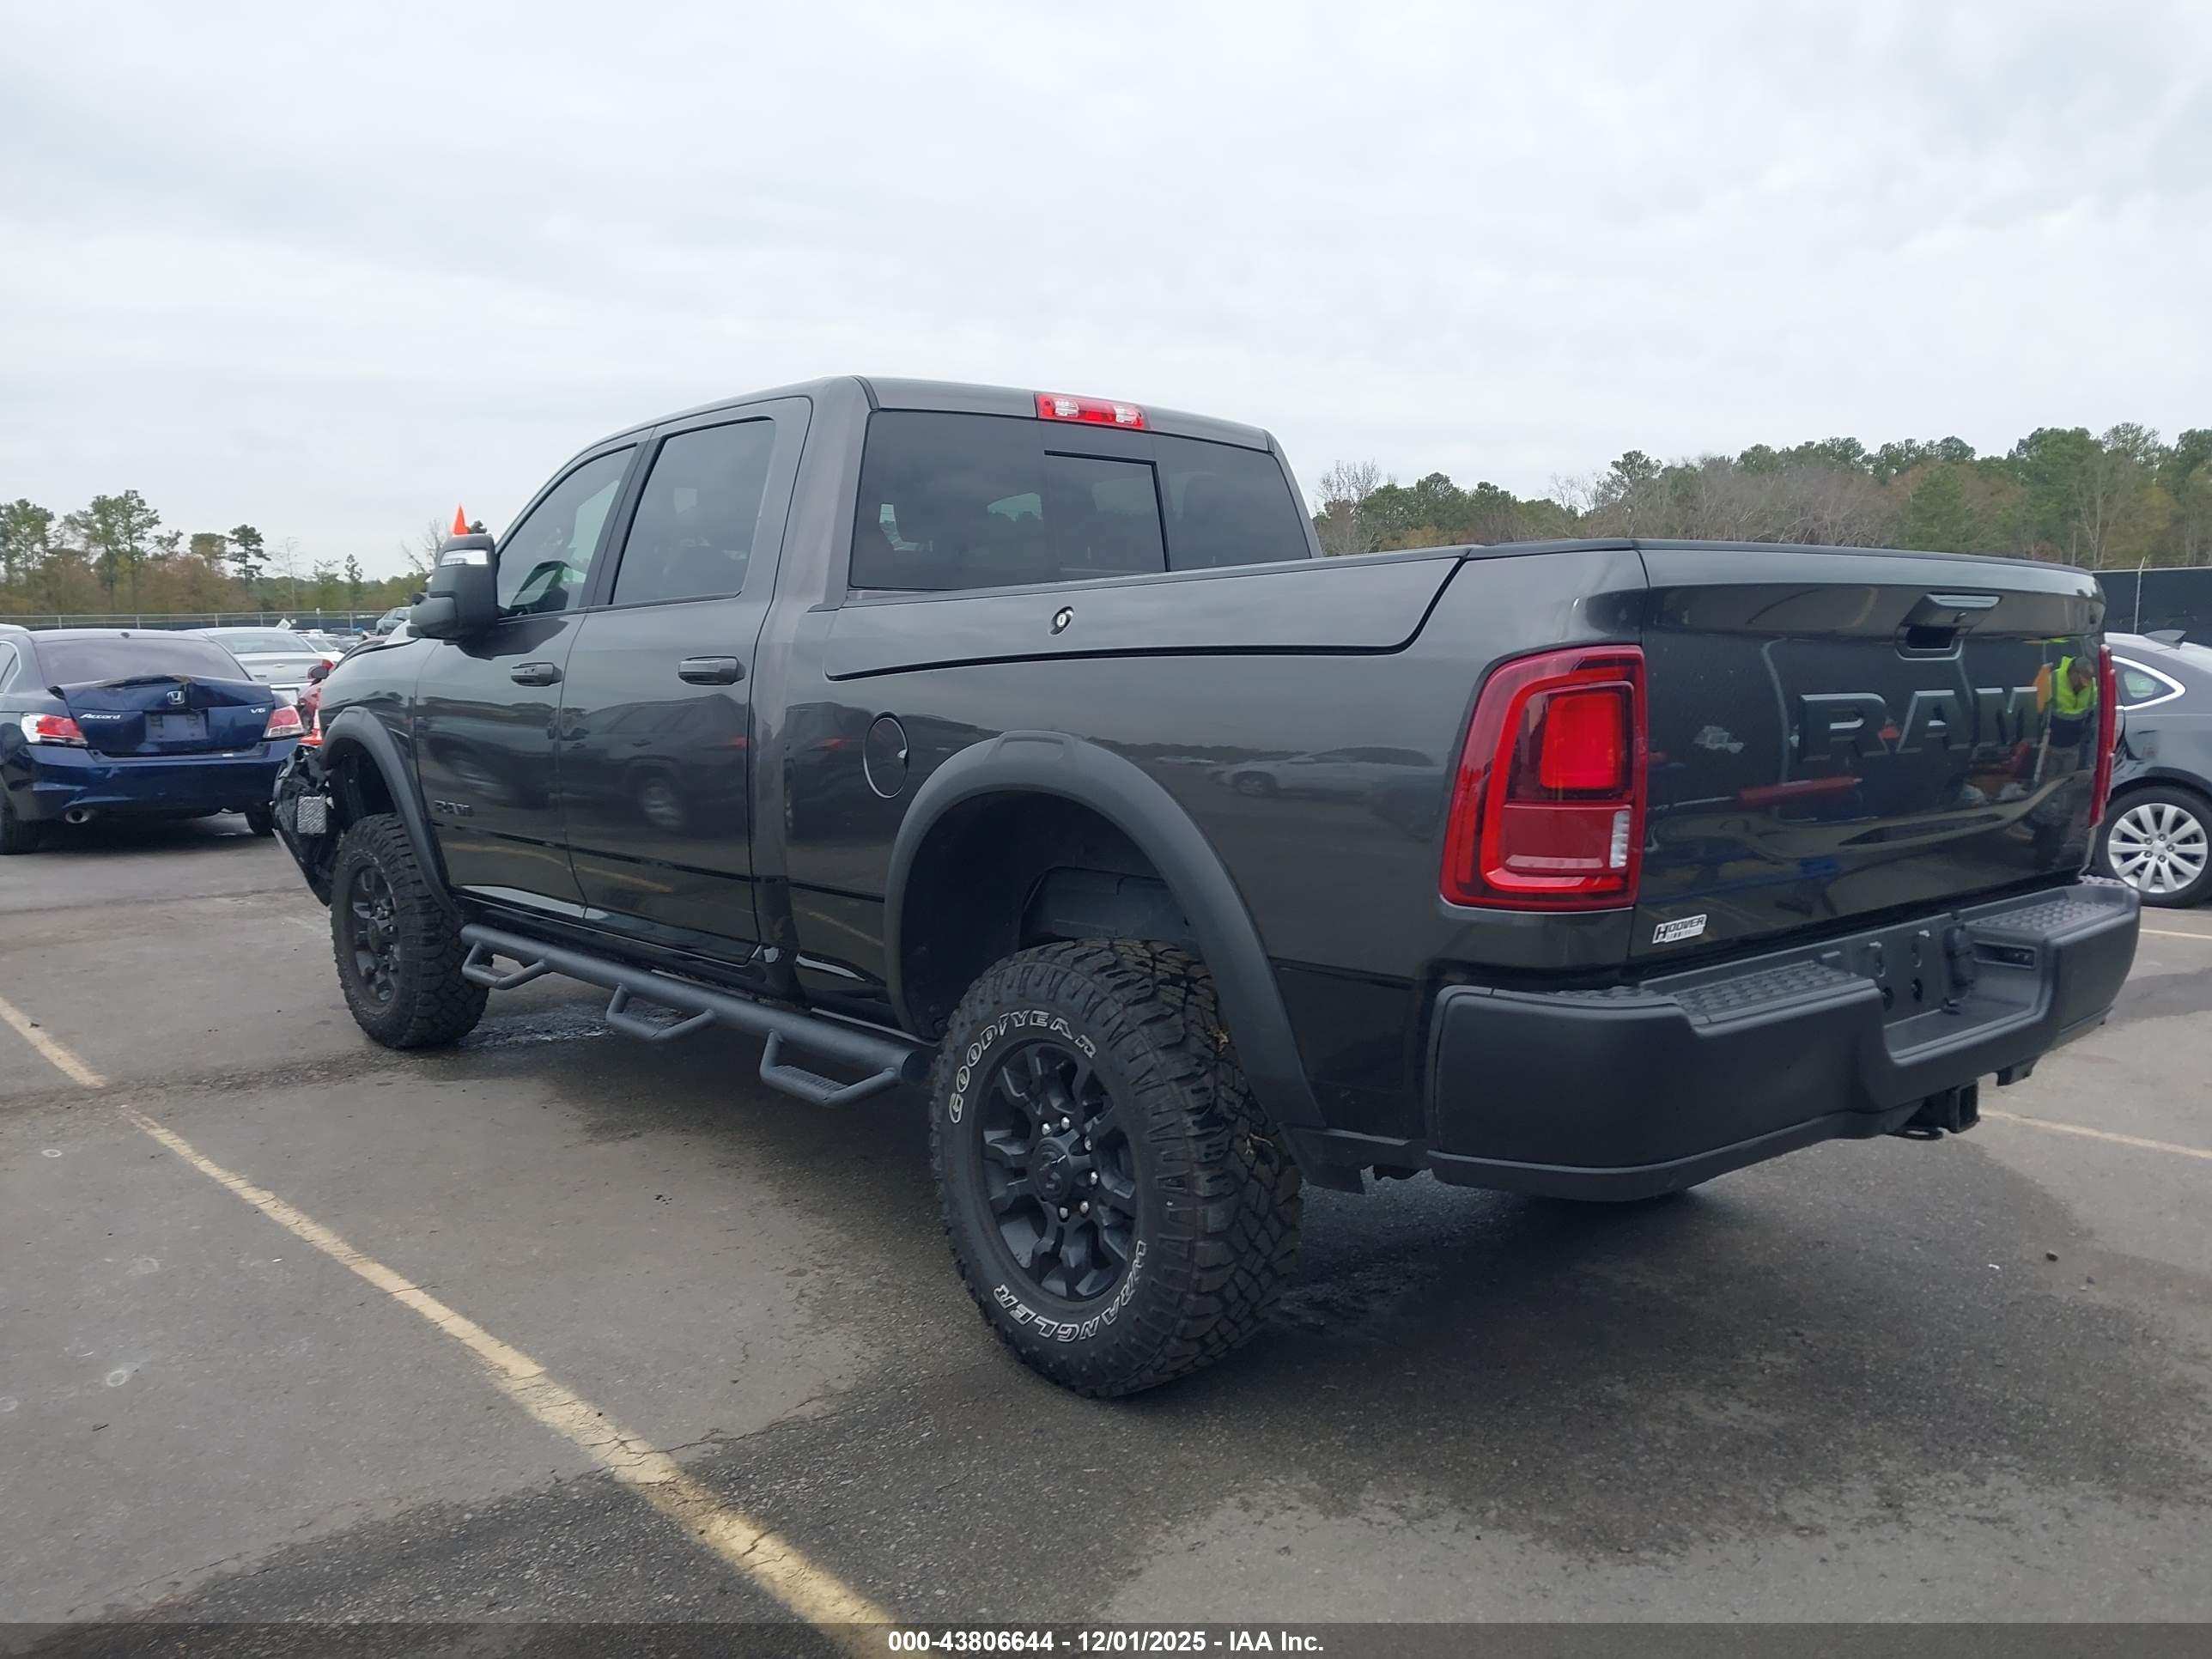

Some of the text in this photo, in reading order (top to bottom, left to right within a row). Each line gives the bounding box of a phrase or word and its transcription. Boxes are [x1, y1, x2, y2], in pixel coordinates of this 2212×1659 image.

[1801, 686, 2042, 761] RAM
[1655, 916, 1705, 941] HOOVER
[949, 1010, 1097, 1123] GOODYEAR
[994, 1240, 1147, 1342] WRANGLER
